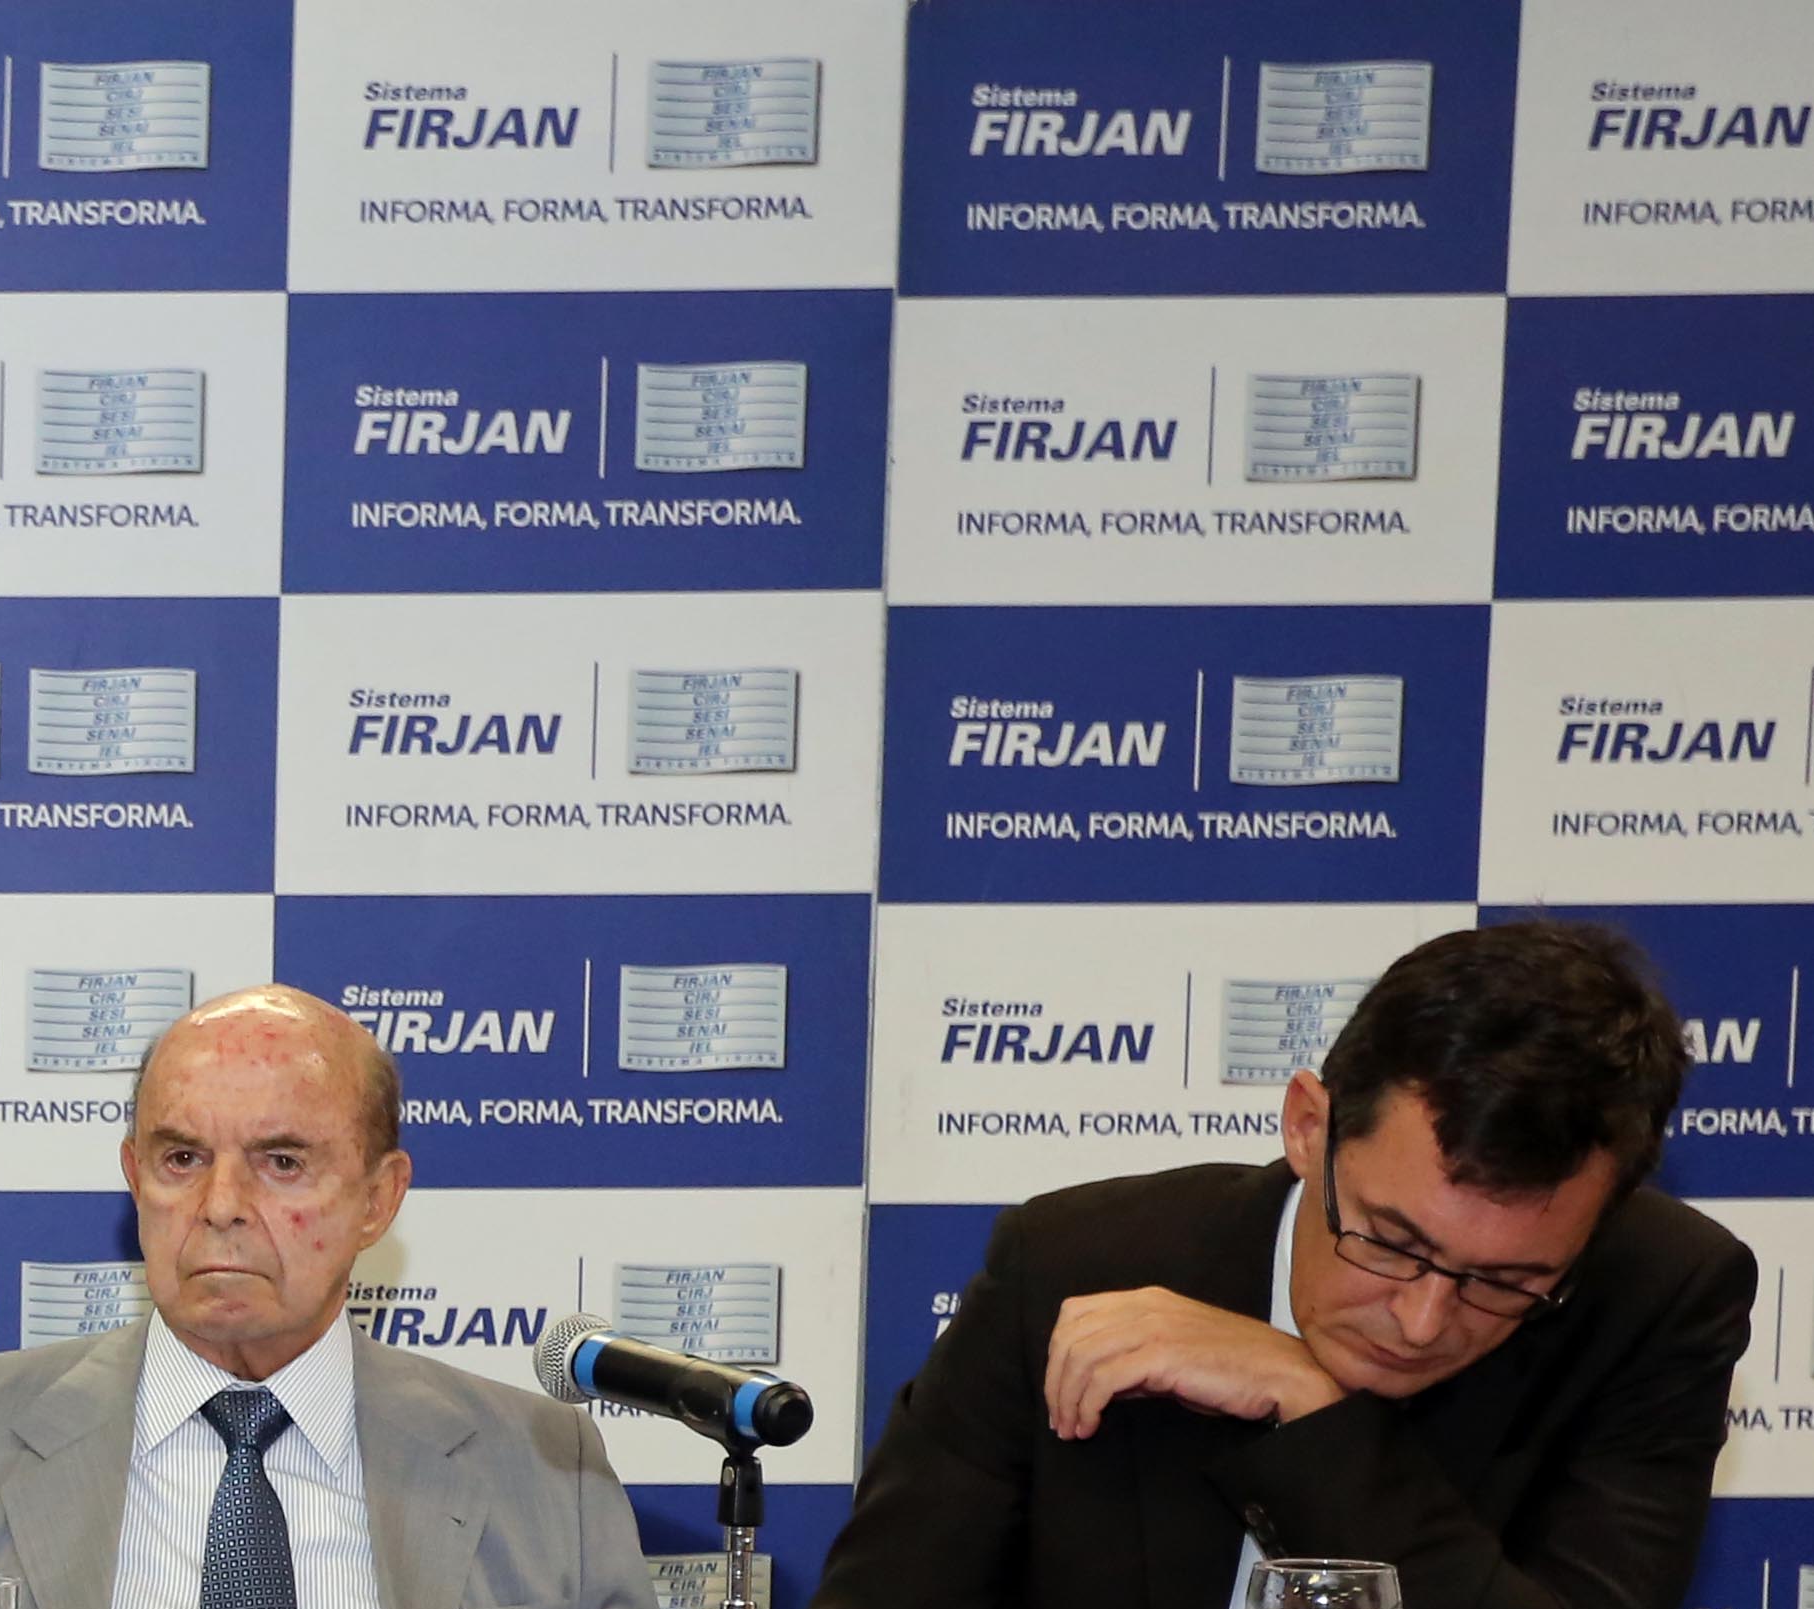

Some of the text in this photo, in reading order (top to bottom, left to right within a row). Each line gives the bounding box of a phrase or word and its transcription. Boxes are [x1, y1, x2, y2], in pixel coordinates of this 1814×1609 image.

[363, 107, 580, 150] FIRJAN
[969, 113, 1192, 157] FIRJAN
[1588, 106, 1812, 150] FIRJAN
[354, 385, 459, 407] Sistema
[353, 411, 572, 455] FIRJAN
[960, 419, 1178, 462] FIRJAN
[1571, 416, 1795, 460] FIRJAN
[348, 689, 451, 708] Sistema
[950, 697, 1054, 719] Sistema
[1559, 696, 1663, 716] Sistema
[348, 714, 562, 756] FIRJAN
[948, 723, 1167, 767] FIRJAN
[1557, 720, 1777, 763] FIRJAN
[340, 982, 445, 1006] Sistema
[941, 998, 1043, 1017] Sistema
[940, 1023, 1155, 1064] FIRJAN
[479, 1099, 784, 1127] FORMA, TRANSFORMA.
[937, 1112, 1184, 1139] INFORMA, FORMA,
